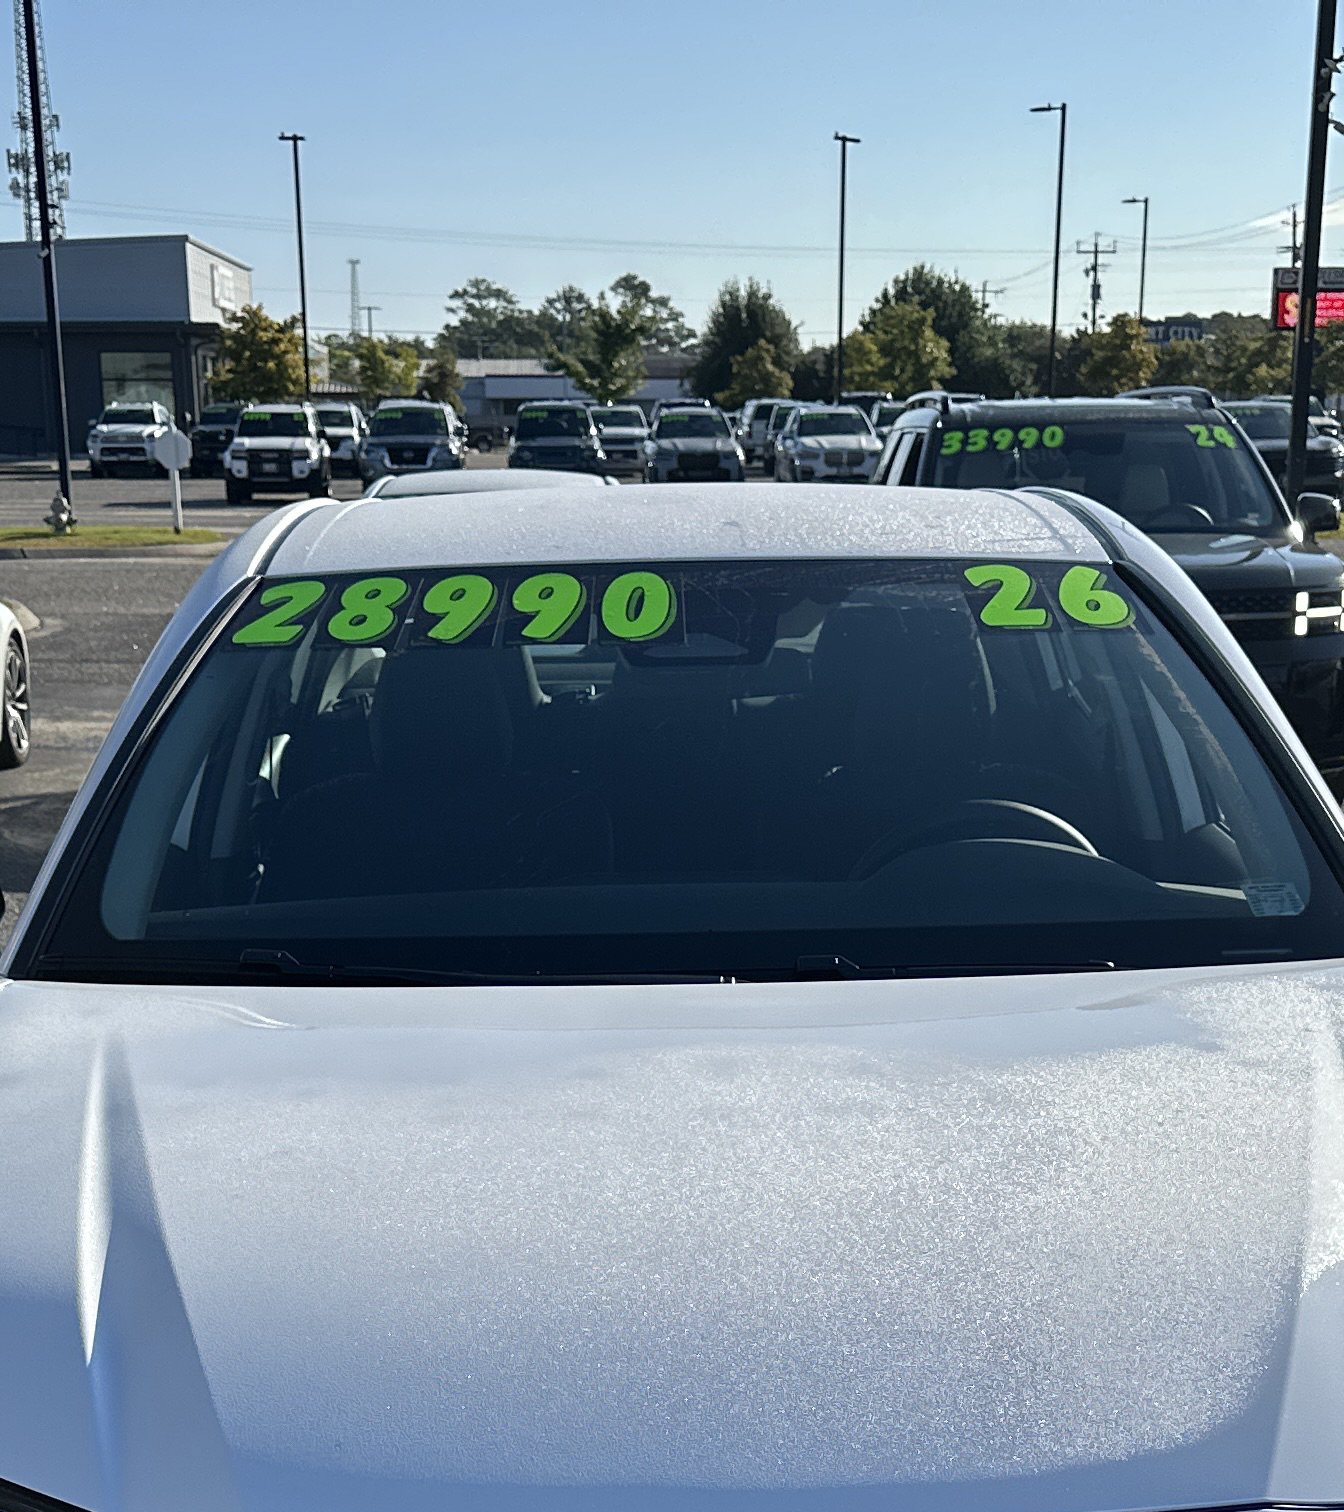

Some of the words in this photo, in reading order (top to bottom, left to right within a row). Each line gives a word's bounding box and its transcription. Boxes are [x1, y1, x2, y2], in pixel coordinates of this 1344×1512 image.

[940, 425, 1065, 455] 33990
[1184, 424, 1236, 449] 24
[232, 572, 677, 646] 28990
[964, 564, 1136, 630] 26
